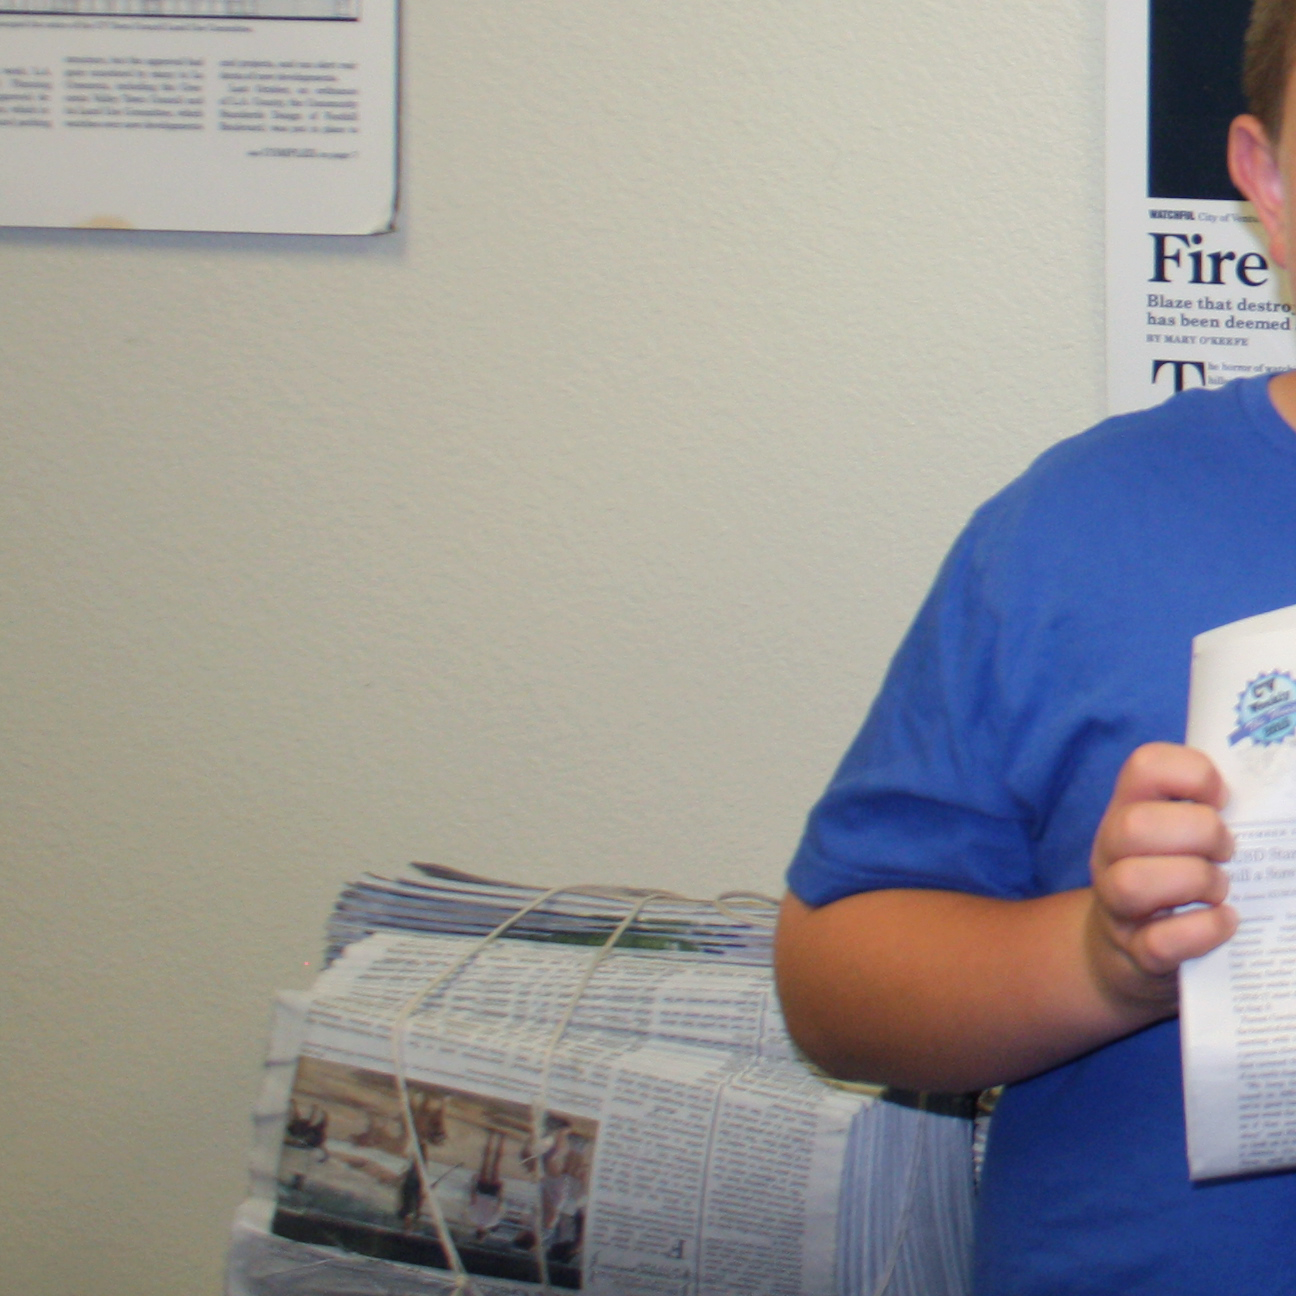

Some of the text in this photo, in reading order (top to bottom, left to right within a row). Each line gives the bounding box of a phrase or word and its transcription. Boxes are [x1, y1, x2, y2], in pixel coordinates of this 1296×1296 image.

[1149, 210, 1194, 220] WATCHFUL
[1148, 232, 1269, 286] Fire
[1146, 294, 1296, 315] Blaze that destro
[1146, 312, 1176, 326] has
[1180, 314, 1220, 328] been
[1224, 315, 1292, 331] deemed
[1146, 334, 1161, 342] BY
[1164, 335, 1197, 344] MARY
[1253, 677, 1275, 698] CV
